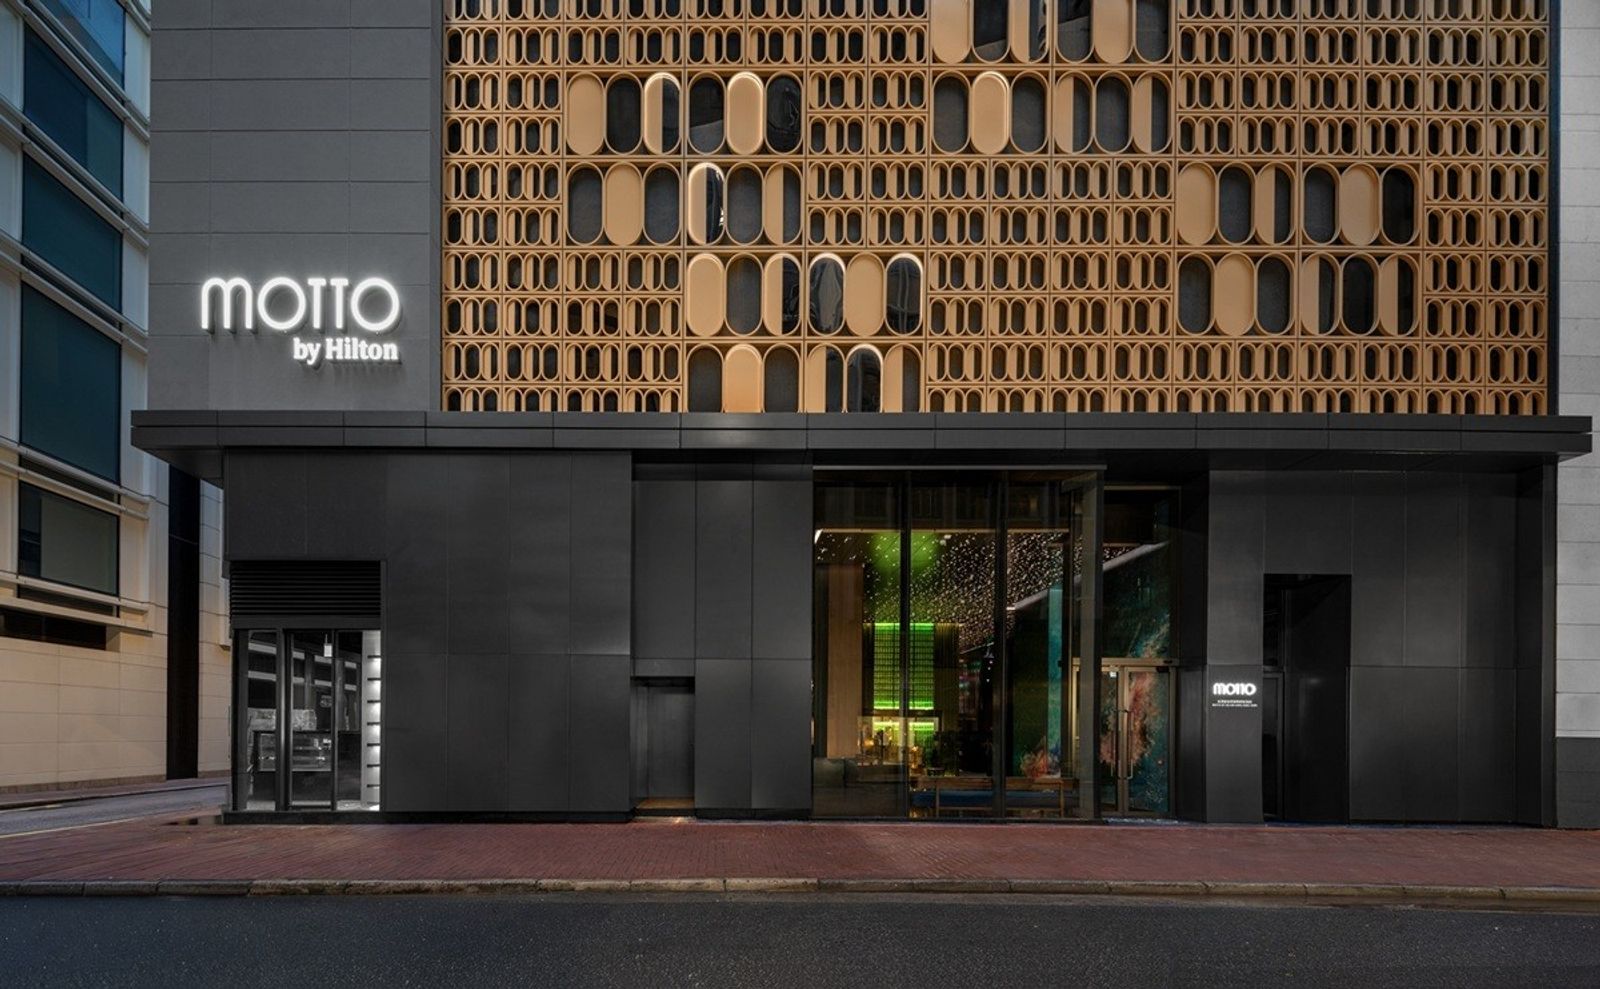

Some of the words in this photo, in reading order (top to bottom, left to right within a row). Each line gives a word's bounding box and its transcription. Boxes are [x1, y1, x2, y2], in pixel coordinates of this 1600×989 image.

[201, 276, 400, 332] MOTTO
[293, 337, 321, 365] by
[325, 337, 398, 361] Hilton
